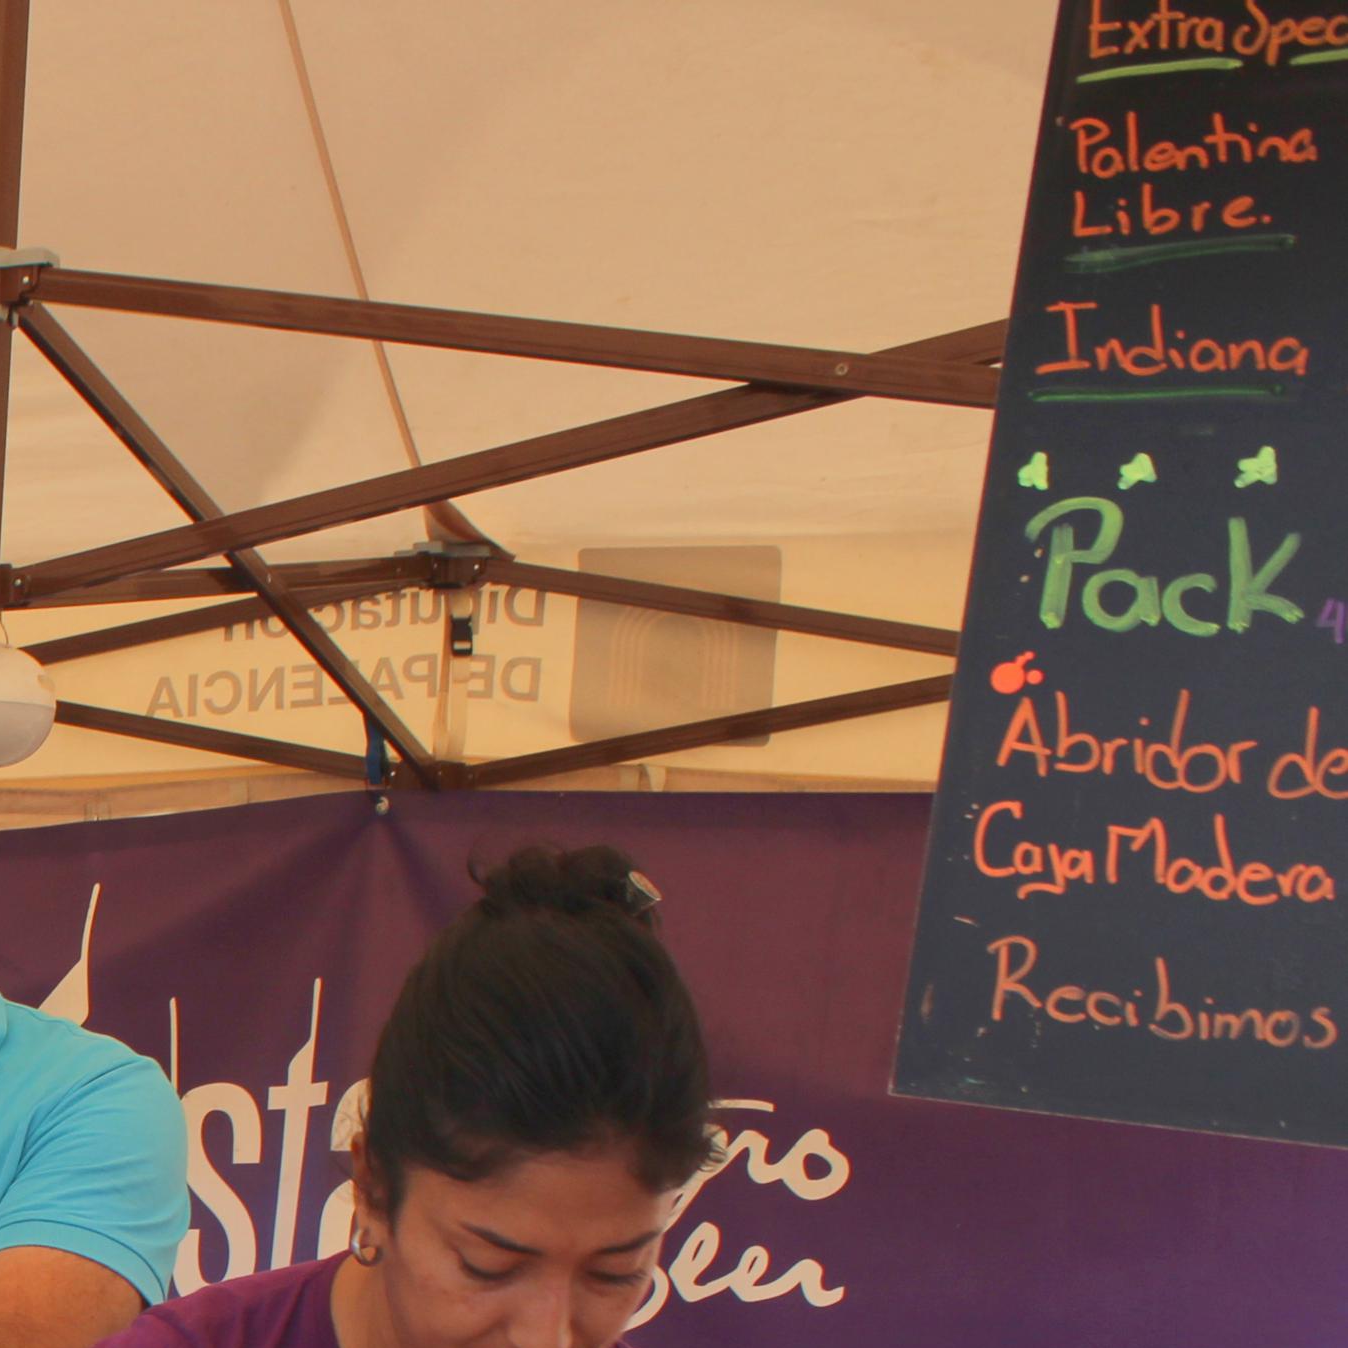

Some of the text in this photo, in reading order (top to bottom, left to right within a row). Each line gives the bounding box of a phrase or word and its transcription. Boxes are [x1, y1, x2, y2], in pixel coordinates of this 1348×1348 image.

[1089, 0, 1224, 58] Extra
[1069, 111, 1318, 178] Palentina
[1073, 183, 1272, 237] Libre.
[1035, 301, 1310, 376] Indiana
[1024, 497, 1304, 637] Pack
[996, 689, 1258, 794] Abridor
[974, 801, 1335, 905] Caja Madera
[987, 936, 1338, 1049] Recibimos
